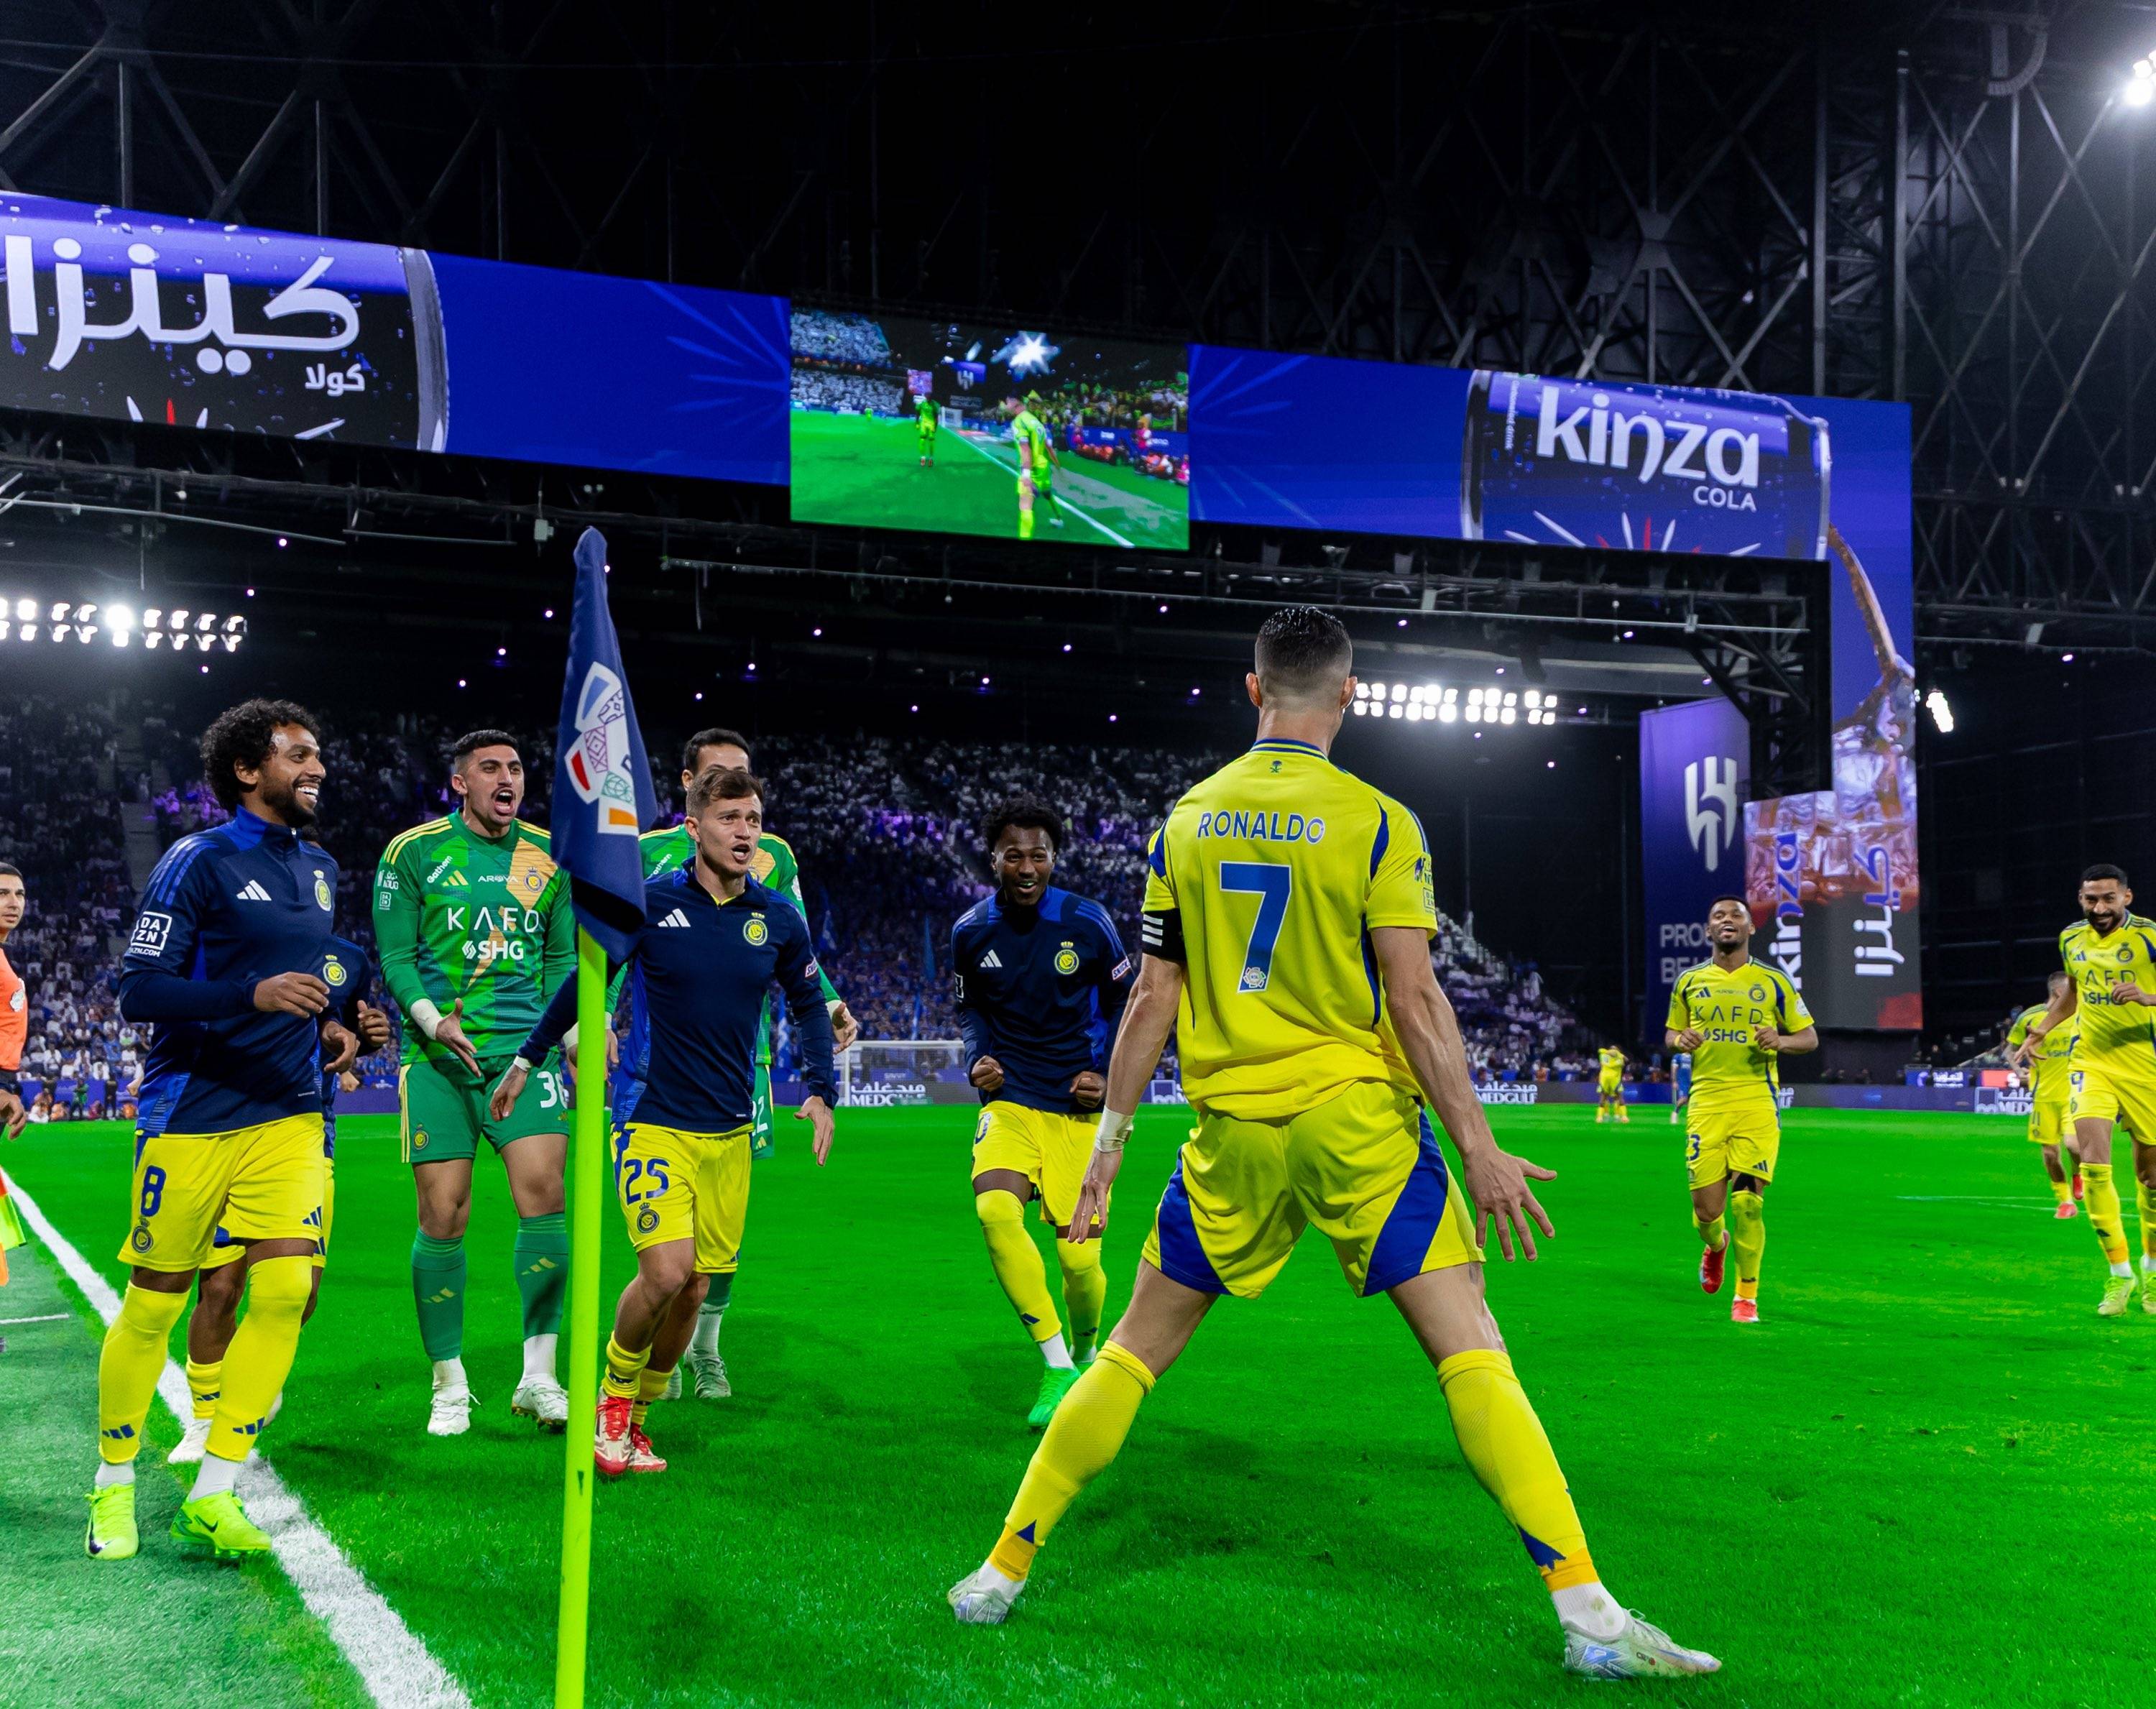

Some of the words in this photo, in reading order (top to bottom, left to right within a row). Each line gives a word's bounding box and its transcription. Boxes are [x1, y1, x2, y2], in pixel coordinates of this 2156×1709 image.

[4, 235, 360, 376] كينزا
[305, 364, 366, 397] كولا
[1537, 386, 1759, 488] kinza
[1692, 485, 1757, 513] COLA
[1197, 810, 1325, 844] RONALDO
[1220, 860, 1291, 993] 7
[477, 939, 525, 960] SHG
[1695, 1005, 1764, 1025] KAFD
[1712, 1028, 1748, 1044] SHG
[140, 1164, 167, 1217] 8
[624, 1158, 671, 1206] 25
